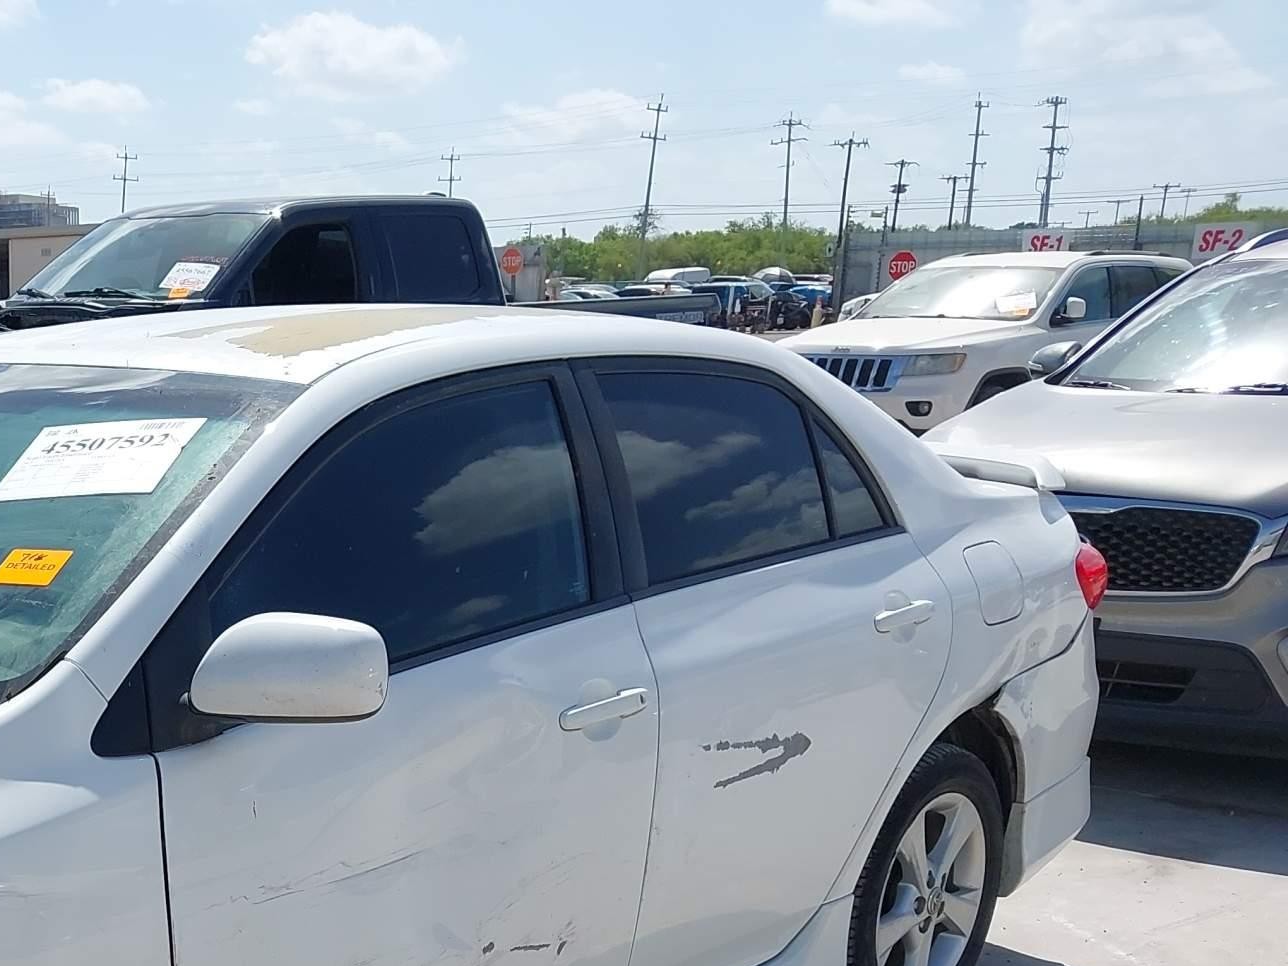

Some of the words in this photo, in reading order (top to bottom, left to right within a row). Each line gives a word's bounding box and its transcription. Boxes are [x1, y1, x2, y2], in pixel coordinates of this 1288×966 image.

[1029, 234, 1064, 251] SF-1
[1198, 229, 1243, 252] SF-2
[502, 256, 521, 267] STOP
[890, 260, 916, 273] STOP
[41, 433, 170, 455] 45507592
[5, 562, 56, 571] DETAILED
